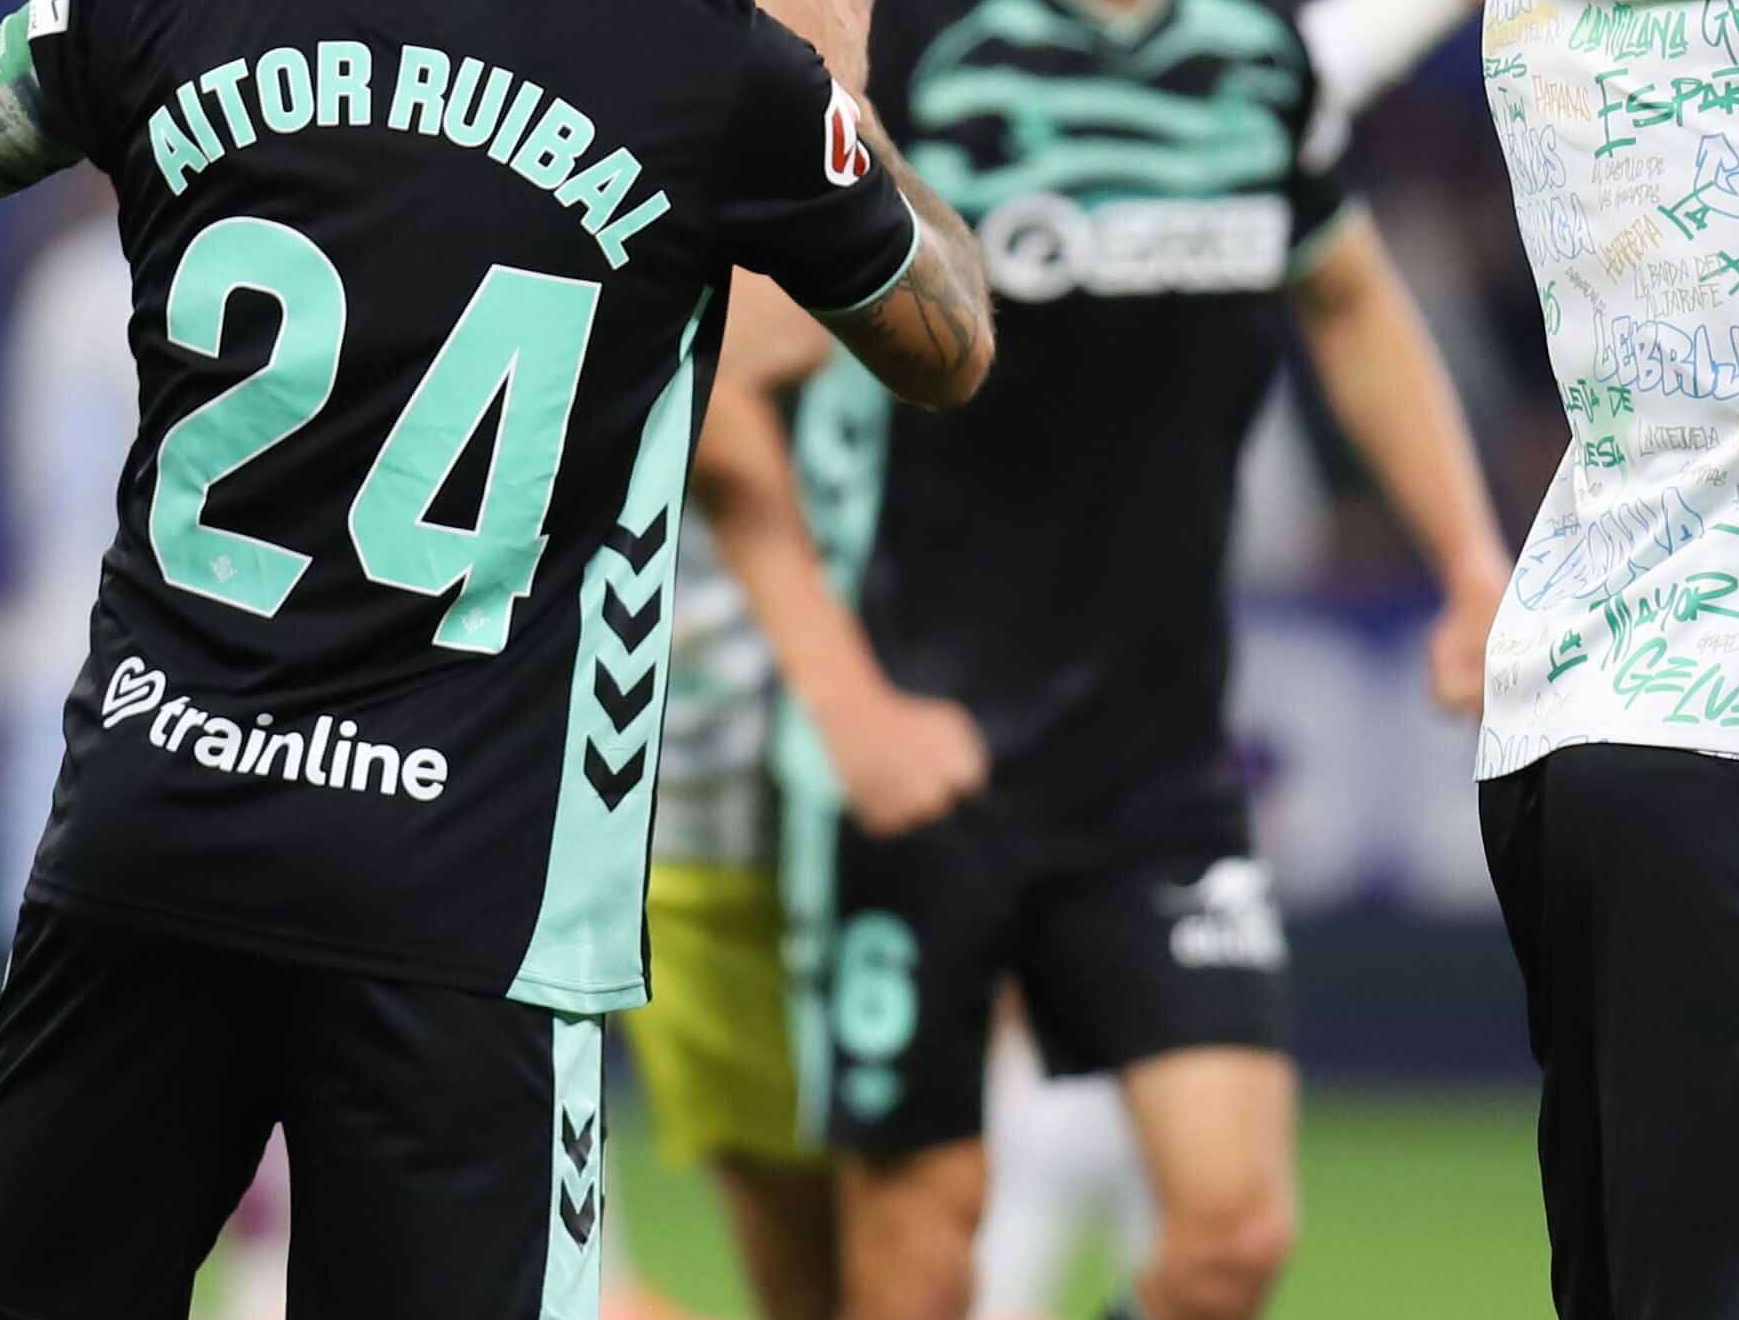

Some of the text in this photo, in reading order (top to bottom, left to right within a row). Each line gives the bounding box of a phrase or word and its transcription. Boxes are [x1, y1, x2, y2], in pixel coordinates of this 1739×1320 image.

[146, 40, 671, 270] AITOR RUIBAL
[148, 216, 602, 654] 24
[149, 692, 448, 801] trainline
